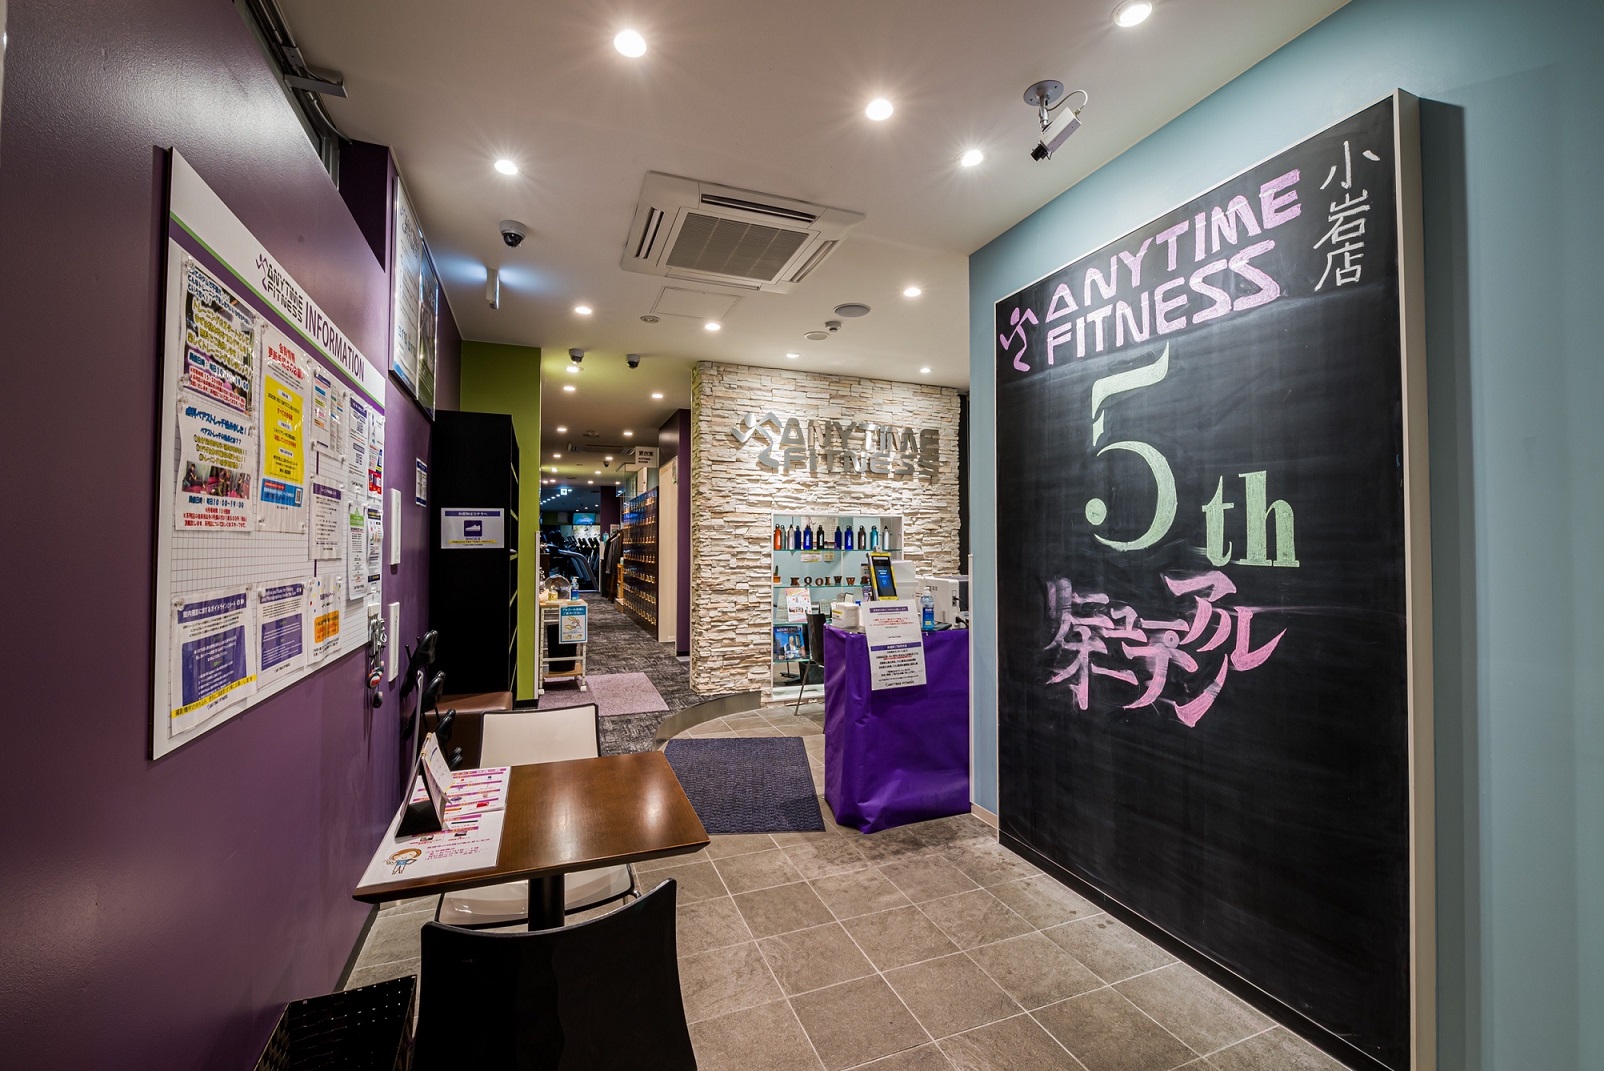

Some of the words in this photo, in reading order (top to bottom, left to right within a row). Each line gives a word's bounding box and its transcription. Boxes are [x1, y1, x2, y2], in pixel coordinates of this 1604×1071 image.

[1044, 168, 1302, 324] ANYTIME
[1313, 139, 1382, 293] 小岩店
[266, 280, 304, 324] FITNESS
[267, 264, 304, 313] ANYTIME
[304, 300, 366, 383] INFORMATION
[1045, 238, 1282, 366] FITNESS
[780, 417, 940, 453] ANYTIME
[783, 447, 940, 476] FITNESS
